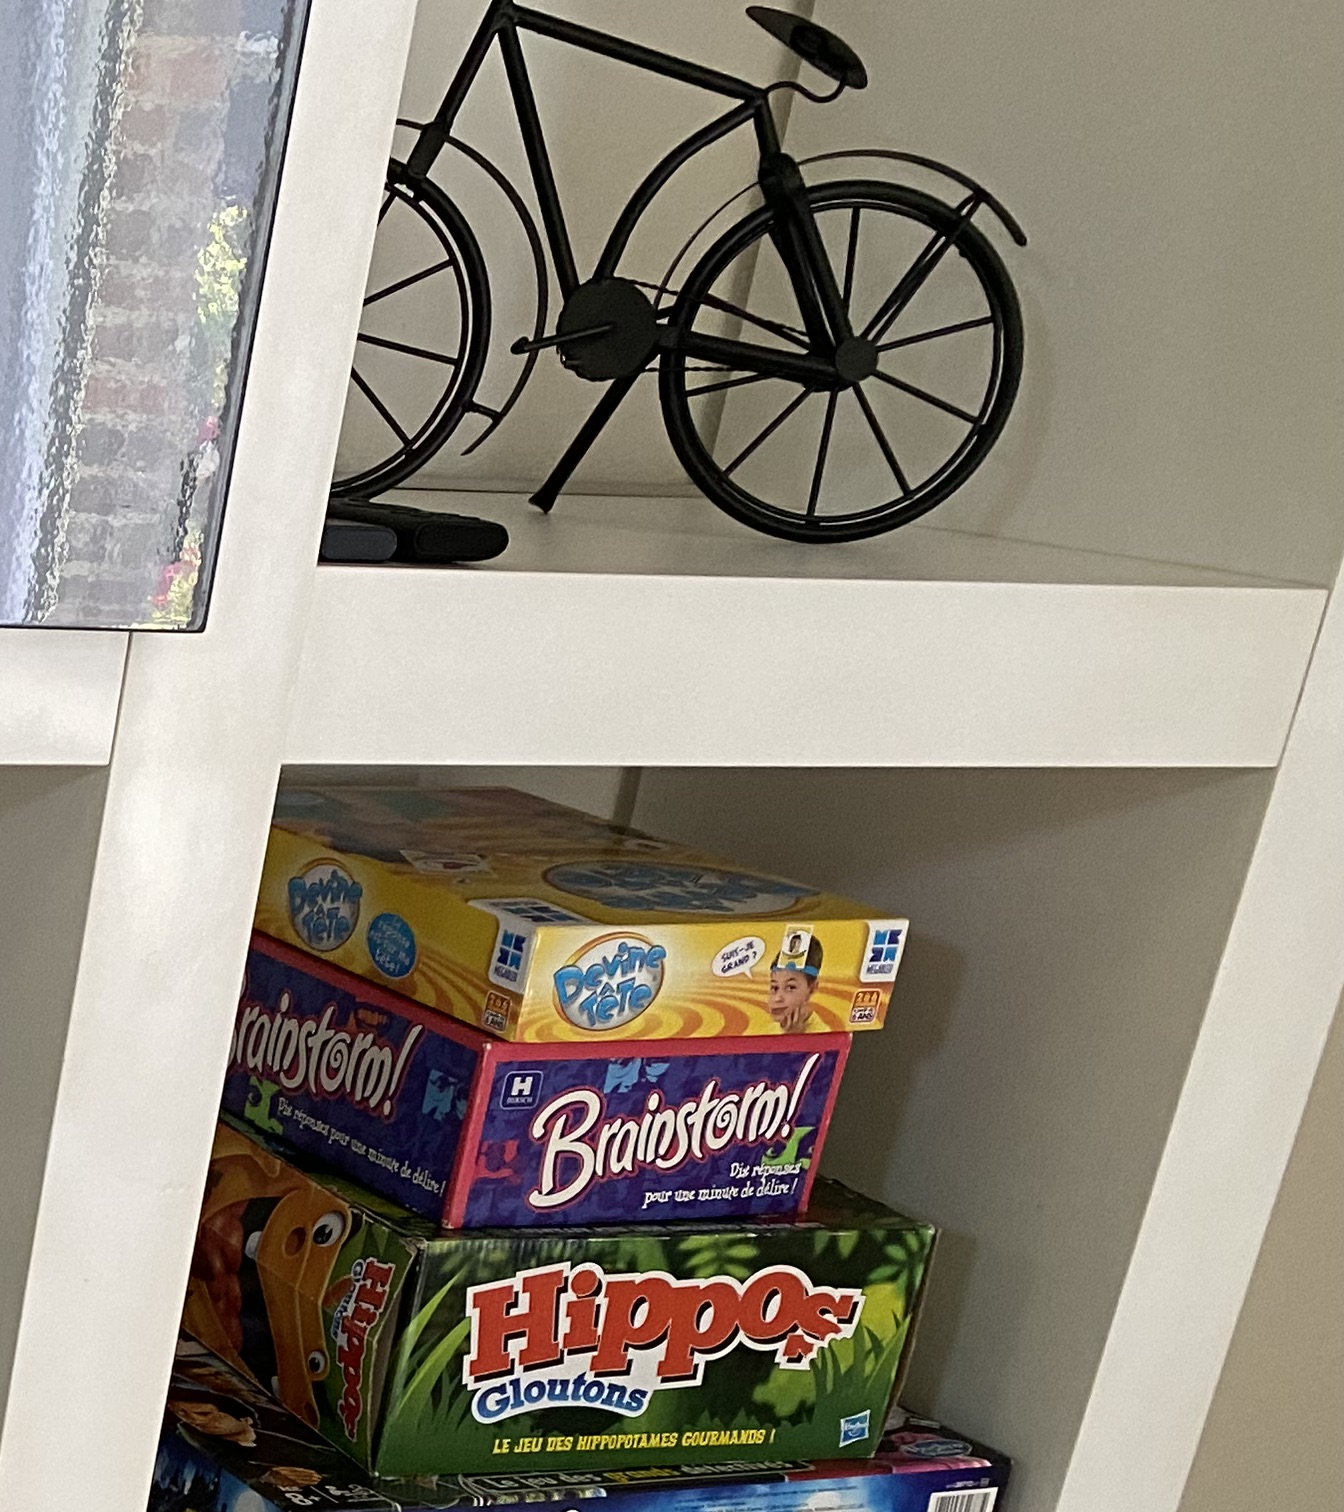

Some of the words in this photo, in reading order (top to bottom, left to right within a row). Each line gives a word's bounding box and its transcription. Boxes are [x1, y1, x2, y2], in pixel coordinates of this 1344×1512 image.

[553, 941, 667, 1003] Devine
[720, 955, 750, 974] GRAND
[230, 992, 424, 1116] rainstorm!
[528, 1053, 820, 1208] Brainstorm!
[368, 1148, 399, 1173] minute
[400, 1160, 412, 1179] de
[730, 1161, 750, 1176] Dix
[752, 1161, 802, 1180] réponses
[642, 1190, 673, 1209] pour
[674, 1188, 696, 1201] une
[698, 1184, 739, 1200] minute
[741, 1183, 755, 1198] de
[758, 1176, 790, 1197] délire
[467, 1267, 860, 1385] Hippos
[476, 1372, 649, 1420] Gloutons
[493, 1438, 511, 1454] LE
[513, 1436, 545, 1453] JEU
[547, 1435, 574, 1452] DES
[577, 1431, 678, 1451] HIPPOPOTAMES
[681, 1429, 766, 1448] GOURMANDS
